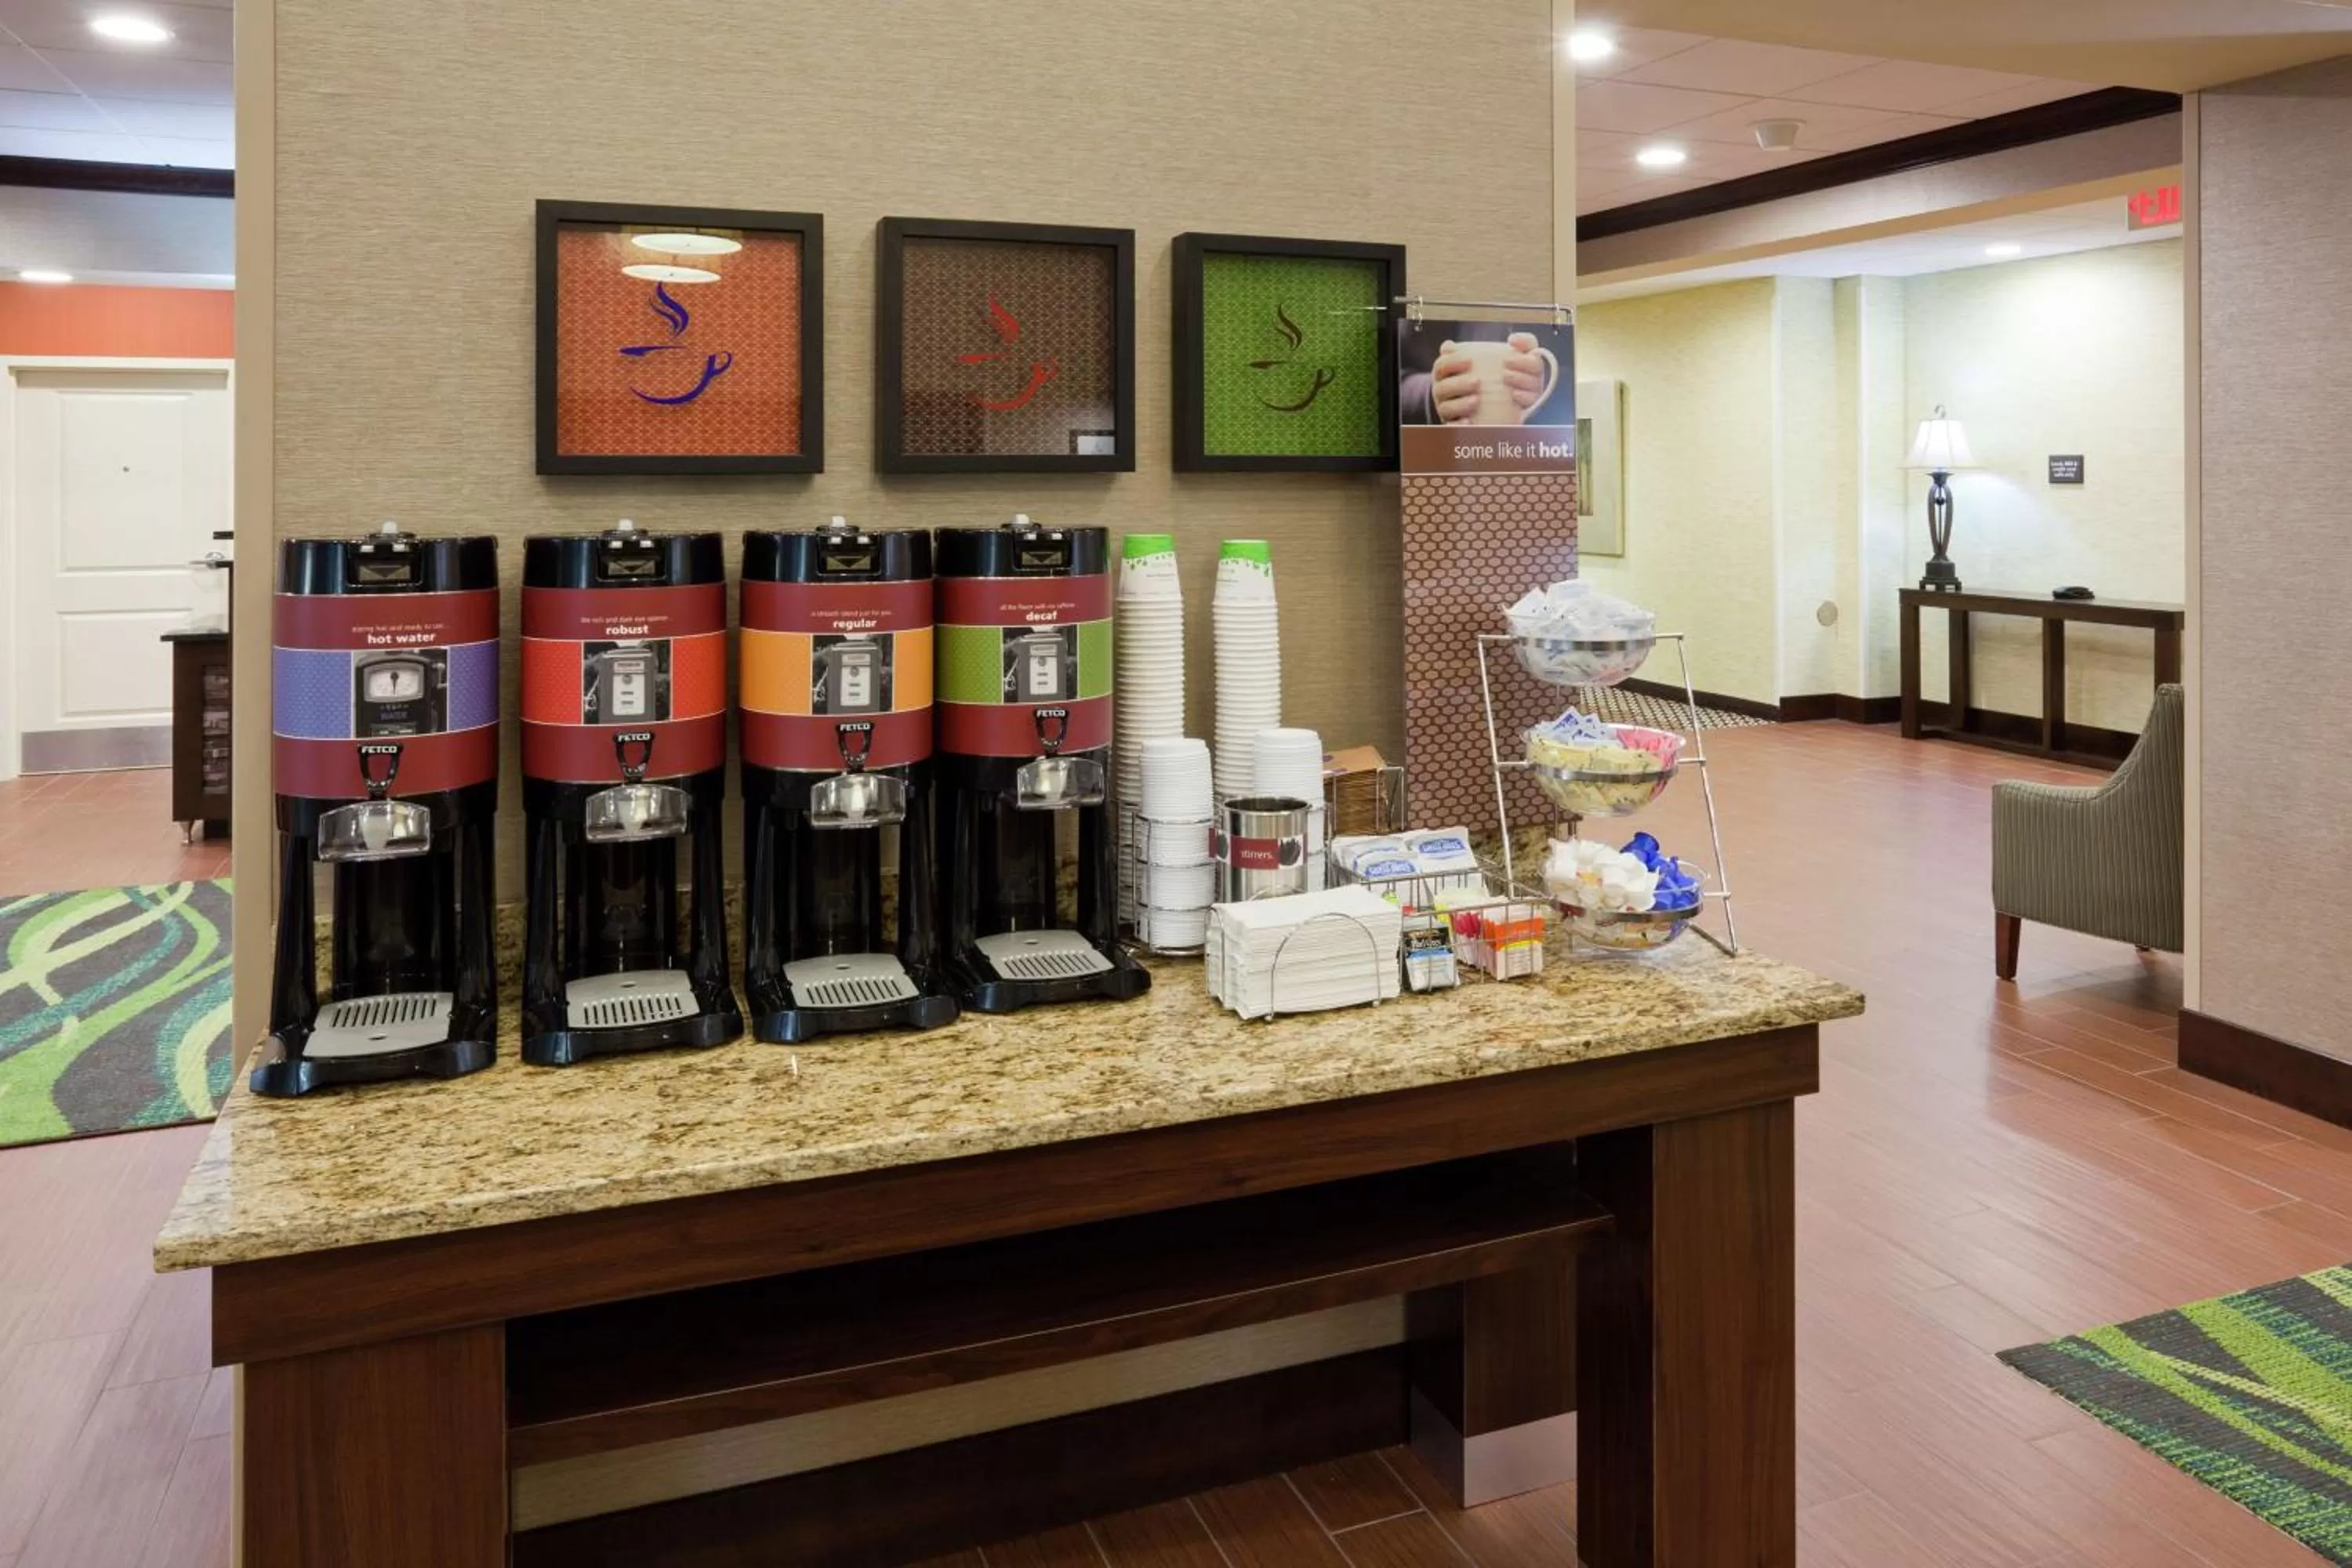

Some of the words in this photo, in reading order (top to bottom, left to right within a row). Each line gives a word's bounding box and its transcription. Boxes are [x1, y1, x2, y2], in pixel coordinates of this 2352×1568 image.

[1454, 445, 1494, 459] some
[1498, 441, 1523, 459] like
[1526, 441, 1537, 459] it
[1539, 441, 1573, 459] hot.
[1025, 611, 1058, 622] decaf
[833, 618, 877, 631] regular
[605, 625, 649, 635] robust
[367, 633, 393, 644] hot
[396, 633, 437, 644] water
[840, 722, 871, 731] FETCO
[618, 732, 651, 742] FETCO
[361, 745, 398, 754] FETCO
